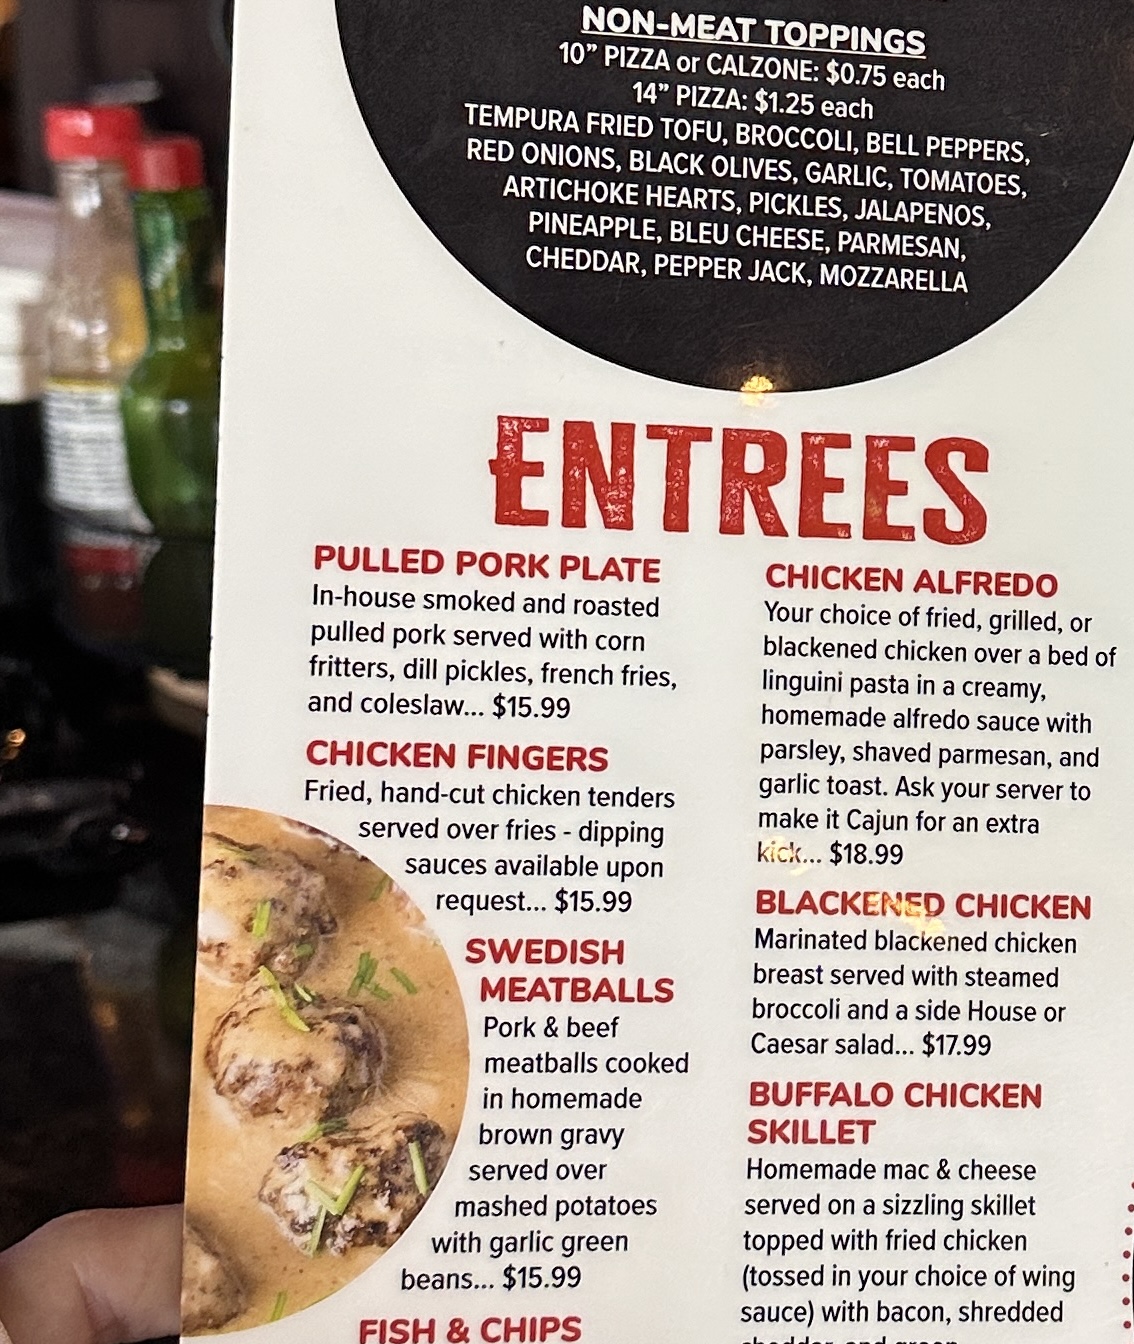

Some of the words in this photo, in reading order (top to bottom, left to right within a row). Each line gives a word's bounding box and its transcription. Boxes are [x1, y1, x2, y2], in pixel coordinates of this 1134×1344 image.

[487, 415, 989, 546] ENTREES
[314, 545, 445, 575] PULLED
[456, 550, 550, 579] PORK
[560, 554, 661, 584] PLATE
[765, 563, 903, 593] CHICKEN
[913, 569, 1058, 598] ALFREDO
[306, 739, 456, 769] CHICKEN
[468, 744, 609, 773] FINGERS
[465, 938, 625, 965] SWEDISH
[480, 976, 674, 1003] MEATBALLS
[446, 1318, 470, 1344] &
[480, 1316, 582, 1344] CHIPS
